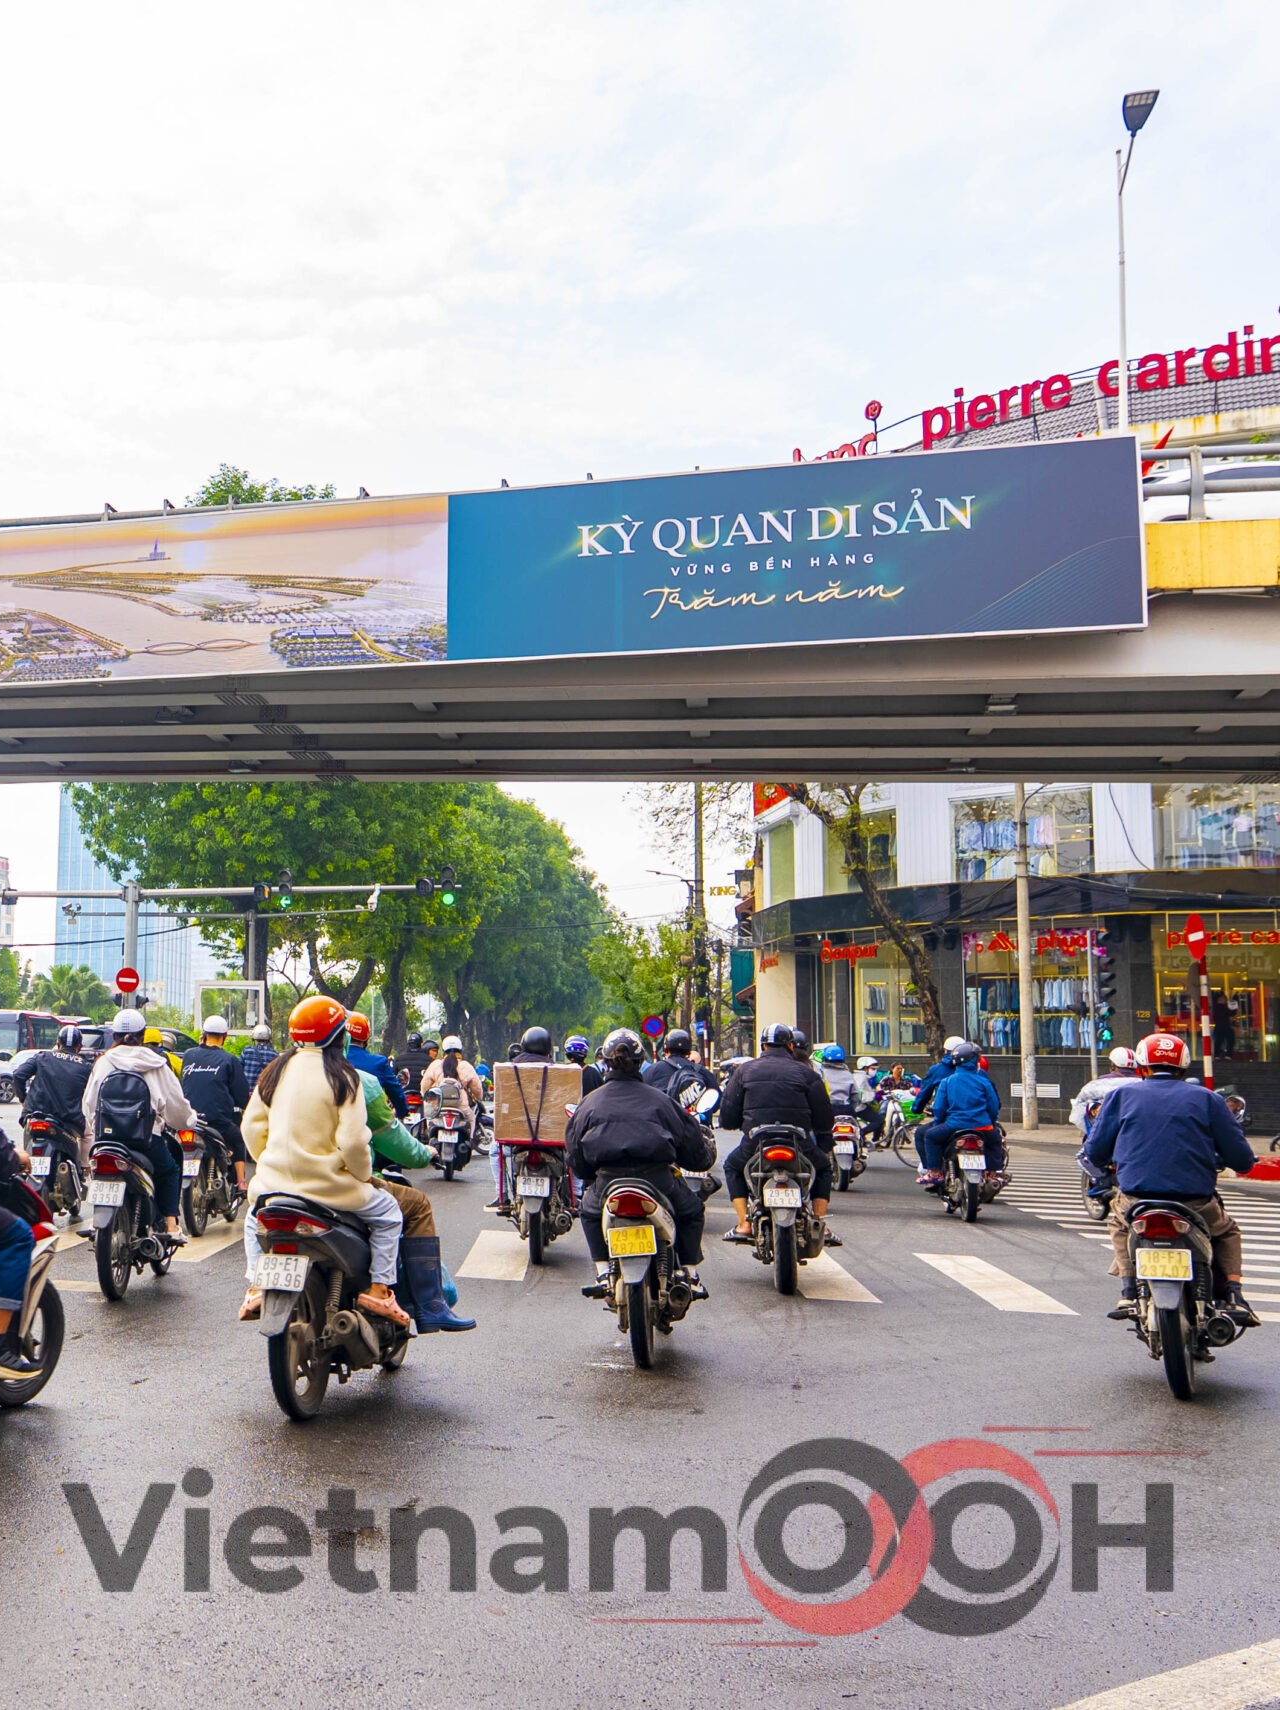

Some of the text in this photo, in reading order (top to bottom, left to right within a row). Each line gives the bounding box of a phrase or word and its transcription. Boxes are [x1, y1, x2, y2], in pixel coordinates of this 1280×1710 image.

[922, 373, 1073, 450] pierre
[576, 488, 977, 558] KỲ QUAN DI SẢN
[670, 561, 732, 577] VỮNG
[810, 552, 875, 567] HÀNG
[643, 580, 905, 620] Trăm năm
[710, 885, 738, 896] KING
[1135, 1009, 1152, 1019] 128
[679, 1081, 707, 1109] NIKE
